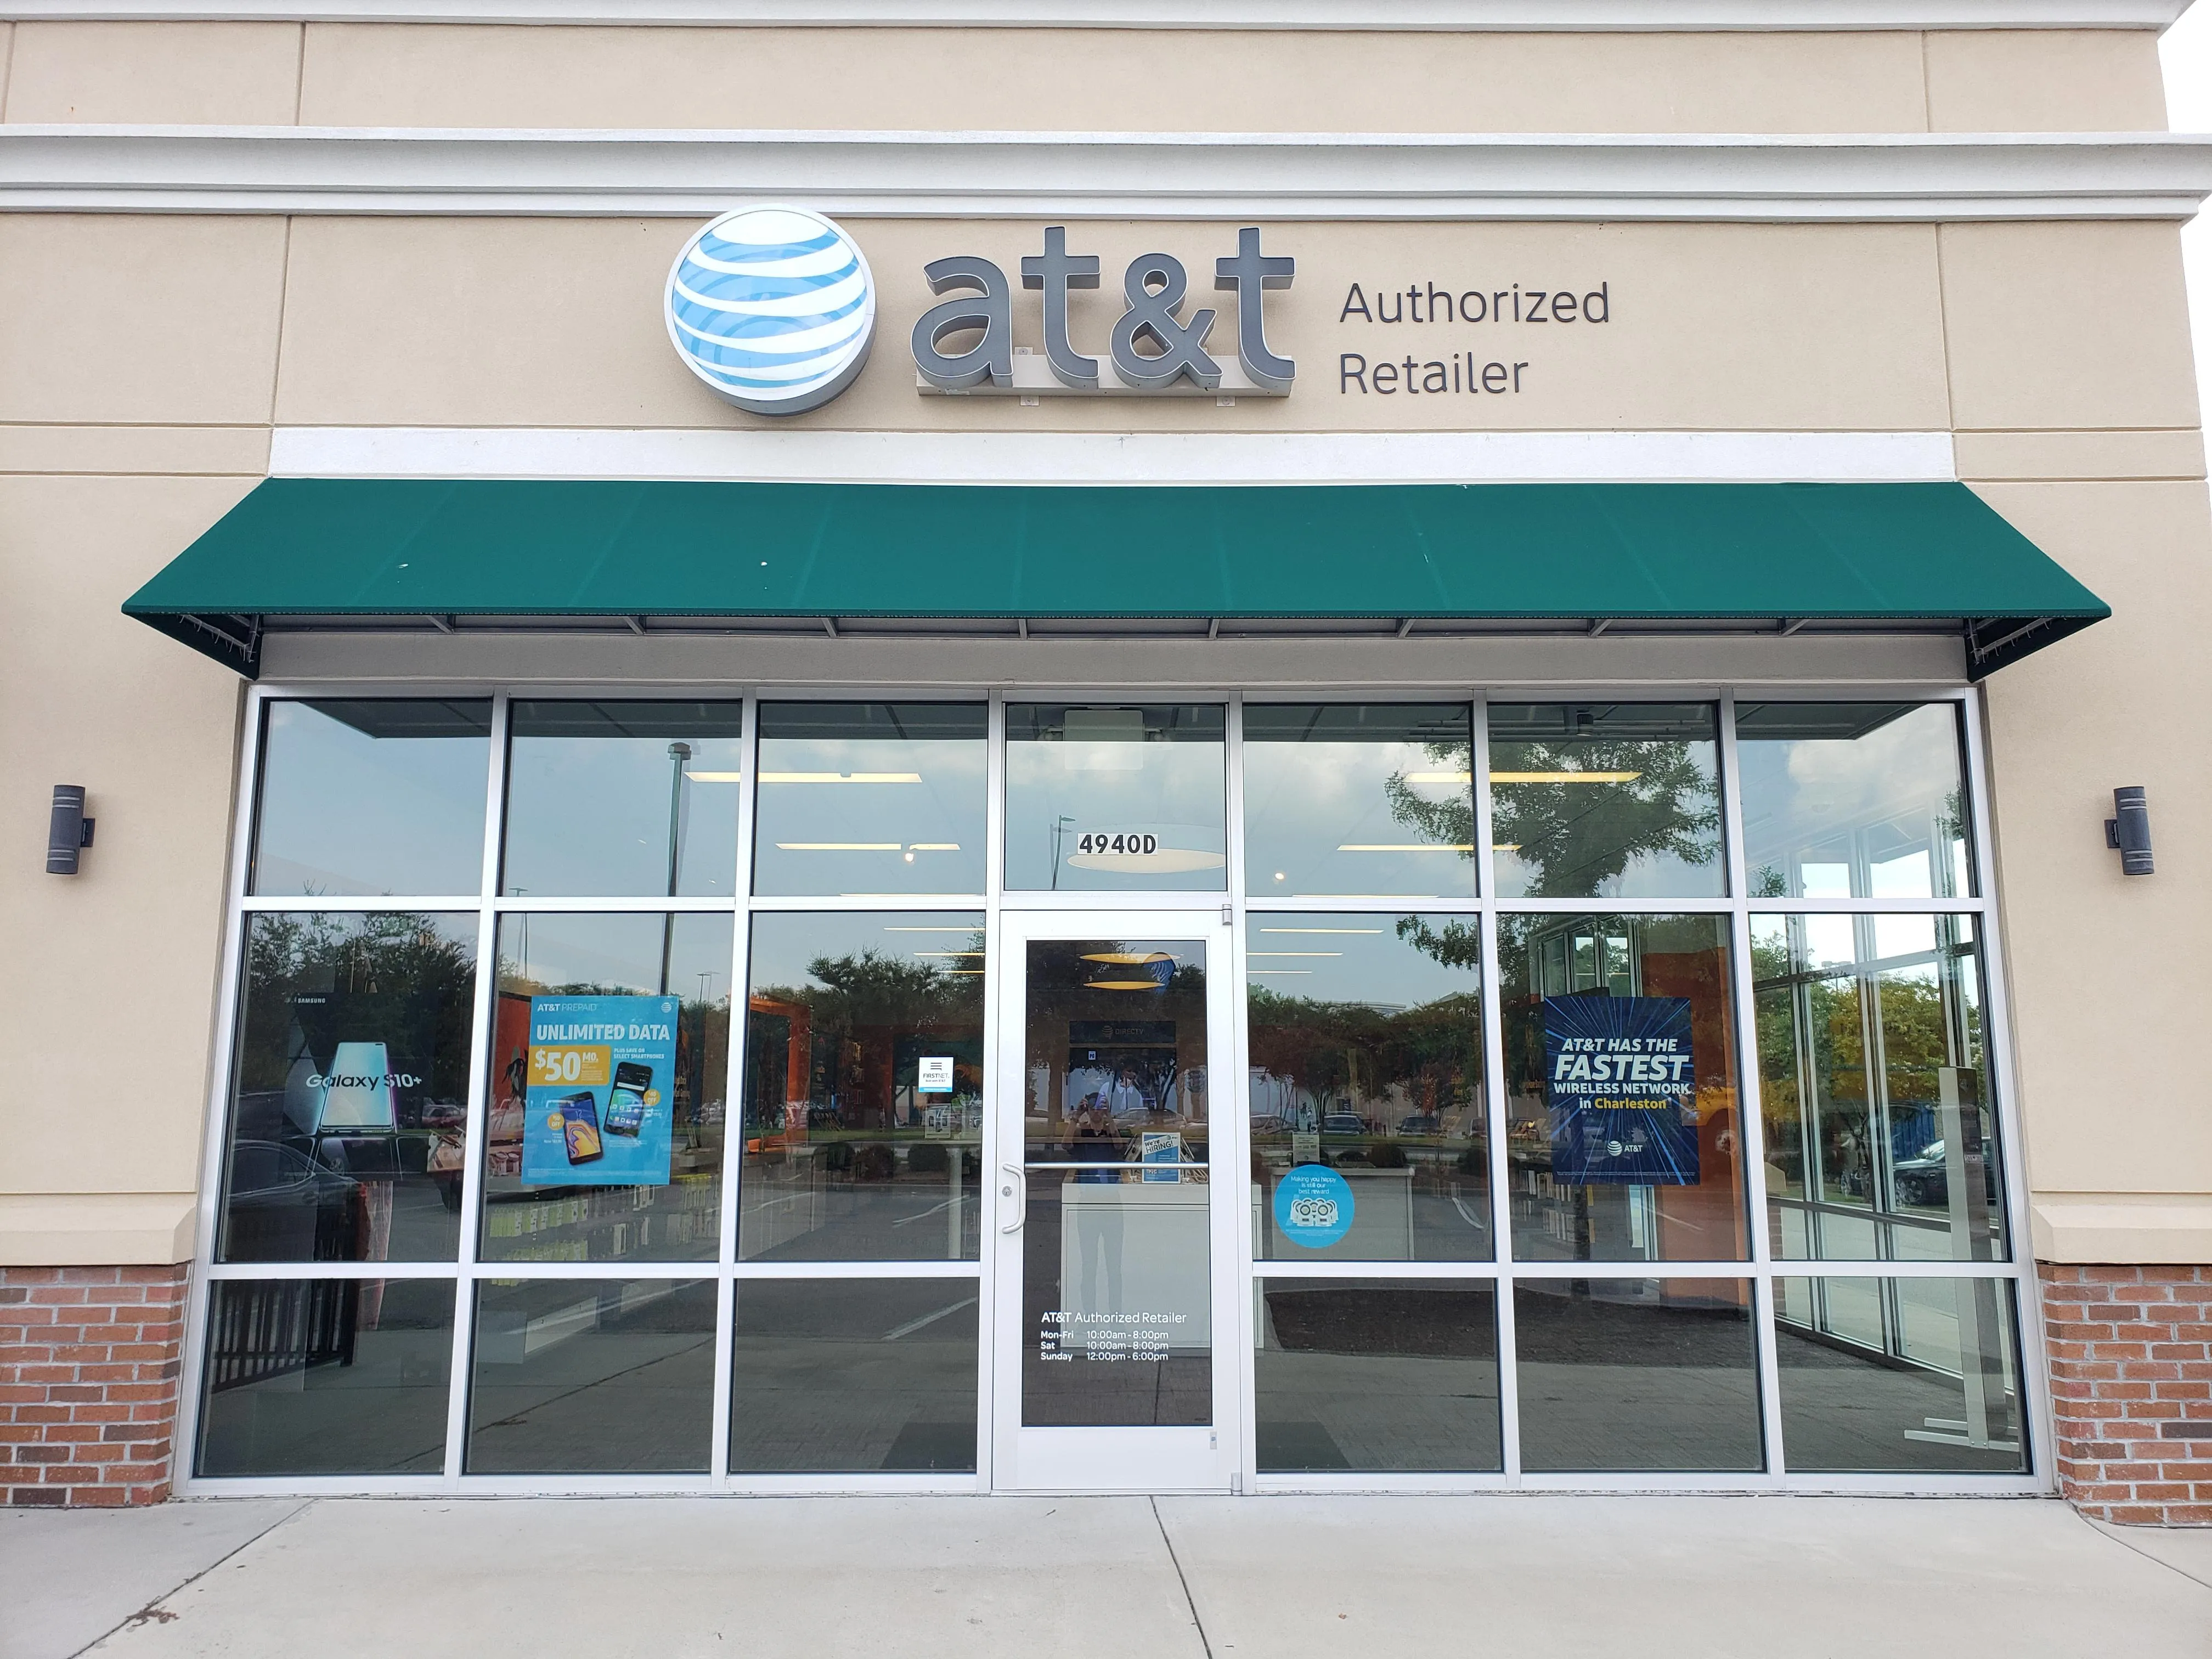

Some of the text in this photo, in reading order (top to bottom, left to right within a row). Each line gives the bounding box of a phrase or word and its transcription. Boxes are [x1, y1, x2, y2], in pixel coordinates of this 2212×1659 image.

[911, 225, 1295, 389] at&t
[1339, 281, 1610, 324] Authorized
[1340, 353, 1529, 394] Retailer
[1079, 834, 1156, 854] 4940D
[537, 1003, 597, 1012] AT&T PREPAID
[537, 1024, 670, 1041] UNLIMITED DATA
[1561, 1039, 1678, 1052] AT&T HAS THE
[534, 1048, 581, 1081] $50
[1554, 1054, 1690, 1081] FASTEST
[306, 1073, 422, 1091] Galaxy S10+
[1553, 1082, 1690, 1094] WIRELESS NETWORK
[1579, 1097, 1667, 1109] in Charleston
[1146, 1141, 1173, 1153] HIRING!
[1041, 1312, 1187, 1323] AT&T Authorized Retailer
[1040, 1330, 1074, 1339] Mon-Fri
[1086, 1330, 1126, 1339] 10:00am
[1133, 1330, 1169, 1341] 8:00pm
[1040, 1341, 1055, 1350] Sat
[1086, 1341, 1126, 1350] 10:00am
[1133, 1341, 1169, 1352] 8:00pm
[1040, 1352, 1073, 1362] Sunday
[1086, 1352, 1126, 1362] 12:00pm
[1132, 1352, 1169, 1362] 6:00pm
